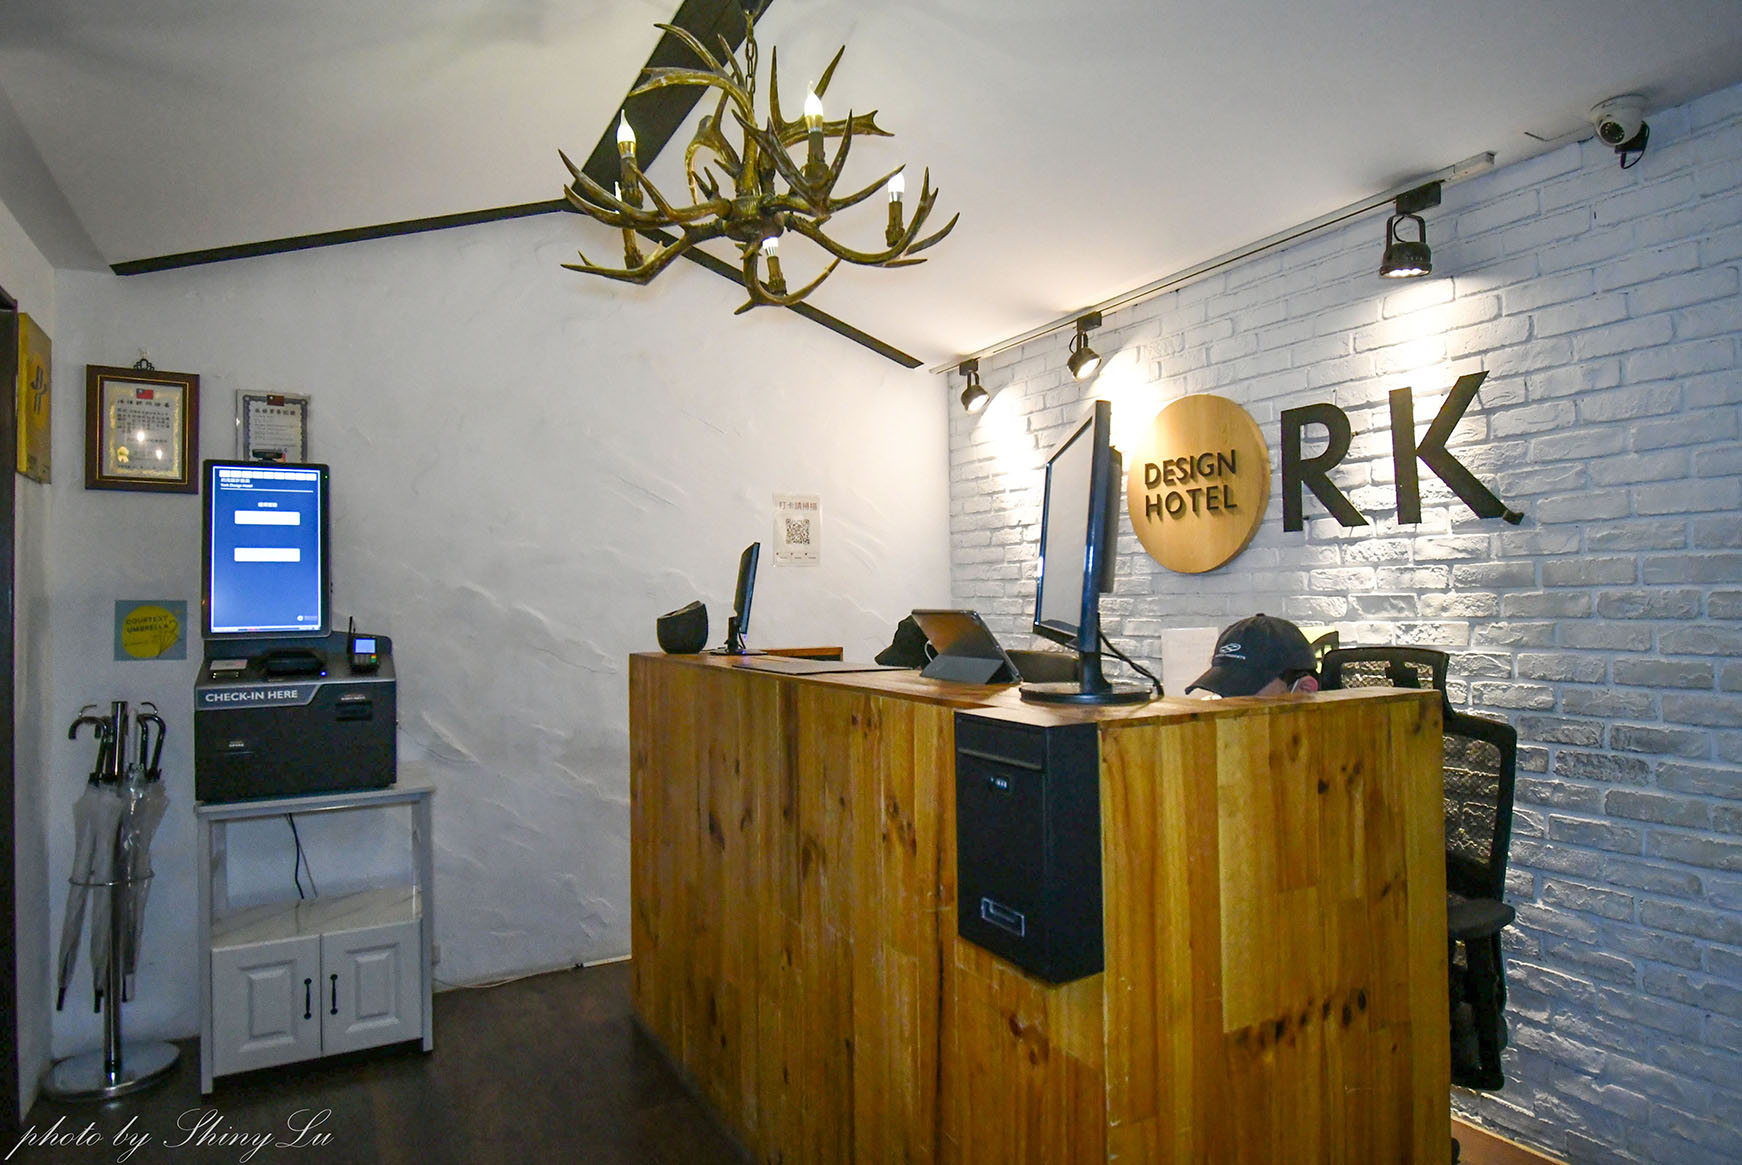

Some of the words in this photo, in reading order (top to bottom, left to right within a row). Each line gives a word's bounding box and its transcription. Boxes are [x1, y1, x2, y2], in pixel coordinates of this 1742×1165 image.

[1144, 449, 1237, 489] DESIGN
[1281, 371, 1508, 533] RK
[1145, 485, 1237, 519] HOTEL
[127, 624, 169, 634] UMBRELLA
[205, 691, 265, 703] CHECK-IN
[268, 690, 298, 700] HERE
